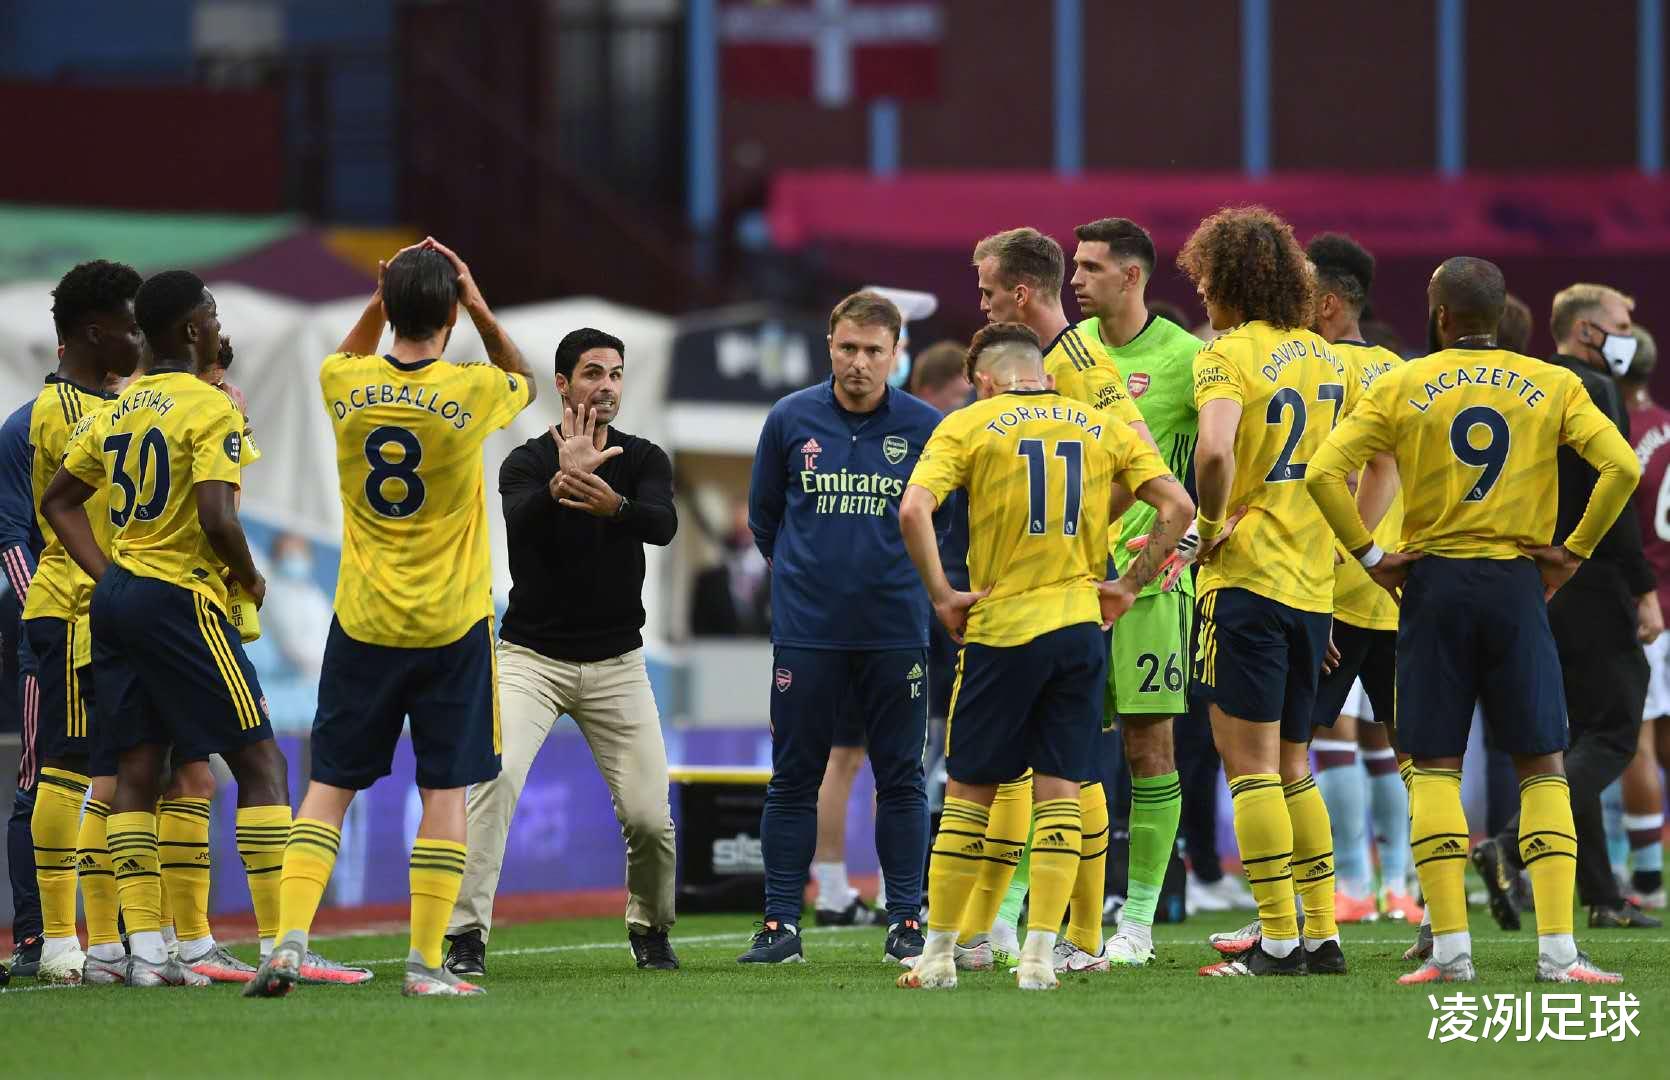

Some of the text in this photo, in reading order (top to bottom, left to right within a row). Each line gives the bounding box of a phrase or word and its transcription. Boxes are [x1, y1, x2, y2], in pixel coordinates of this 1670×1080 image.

[1262, 340, 1307, 383] DAVID
[111, 389, 175, 427] NKETIAH
[333, 384, 473, 431] D.CEBALLOS
[1408, 367, 1546, 413] LACAZETTE
[986, 406, 1103, 440] TORREIRA
[363, 425, 426, 519] 8
[1449, 405, 1511, 503] 9
[103, 427, 171, 528] 30
[800, 467, 903, 496] Emirates
[1016, 438, 1083, 536] 11
[816, 495, 887, 517] FLY BETTER
[1136, 652, 1184, 694] 26
